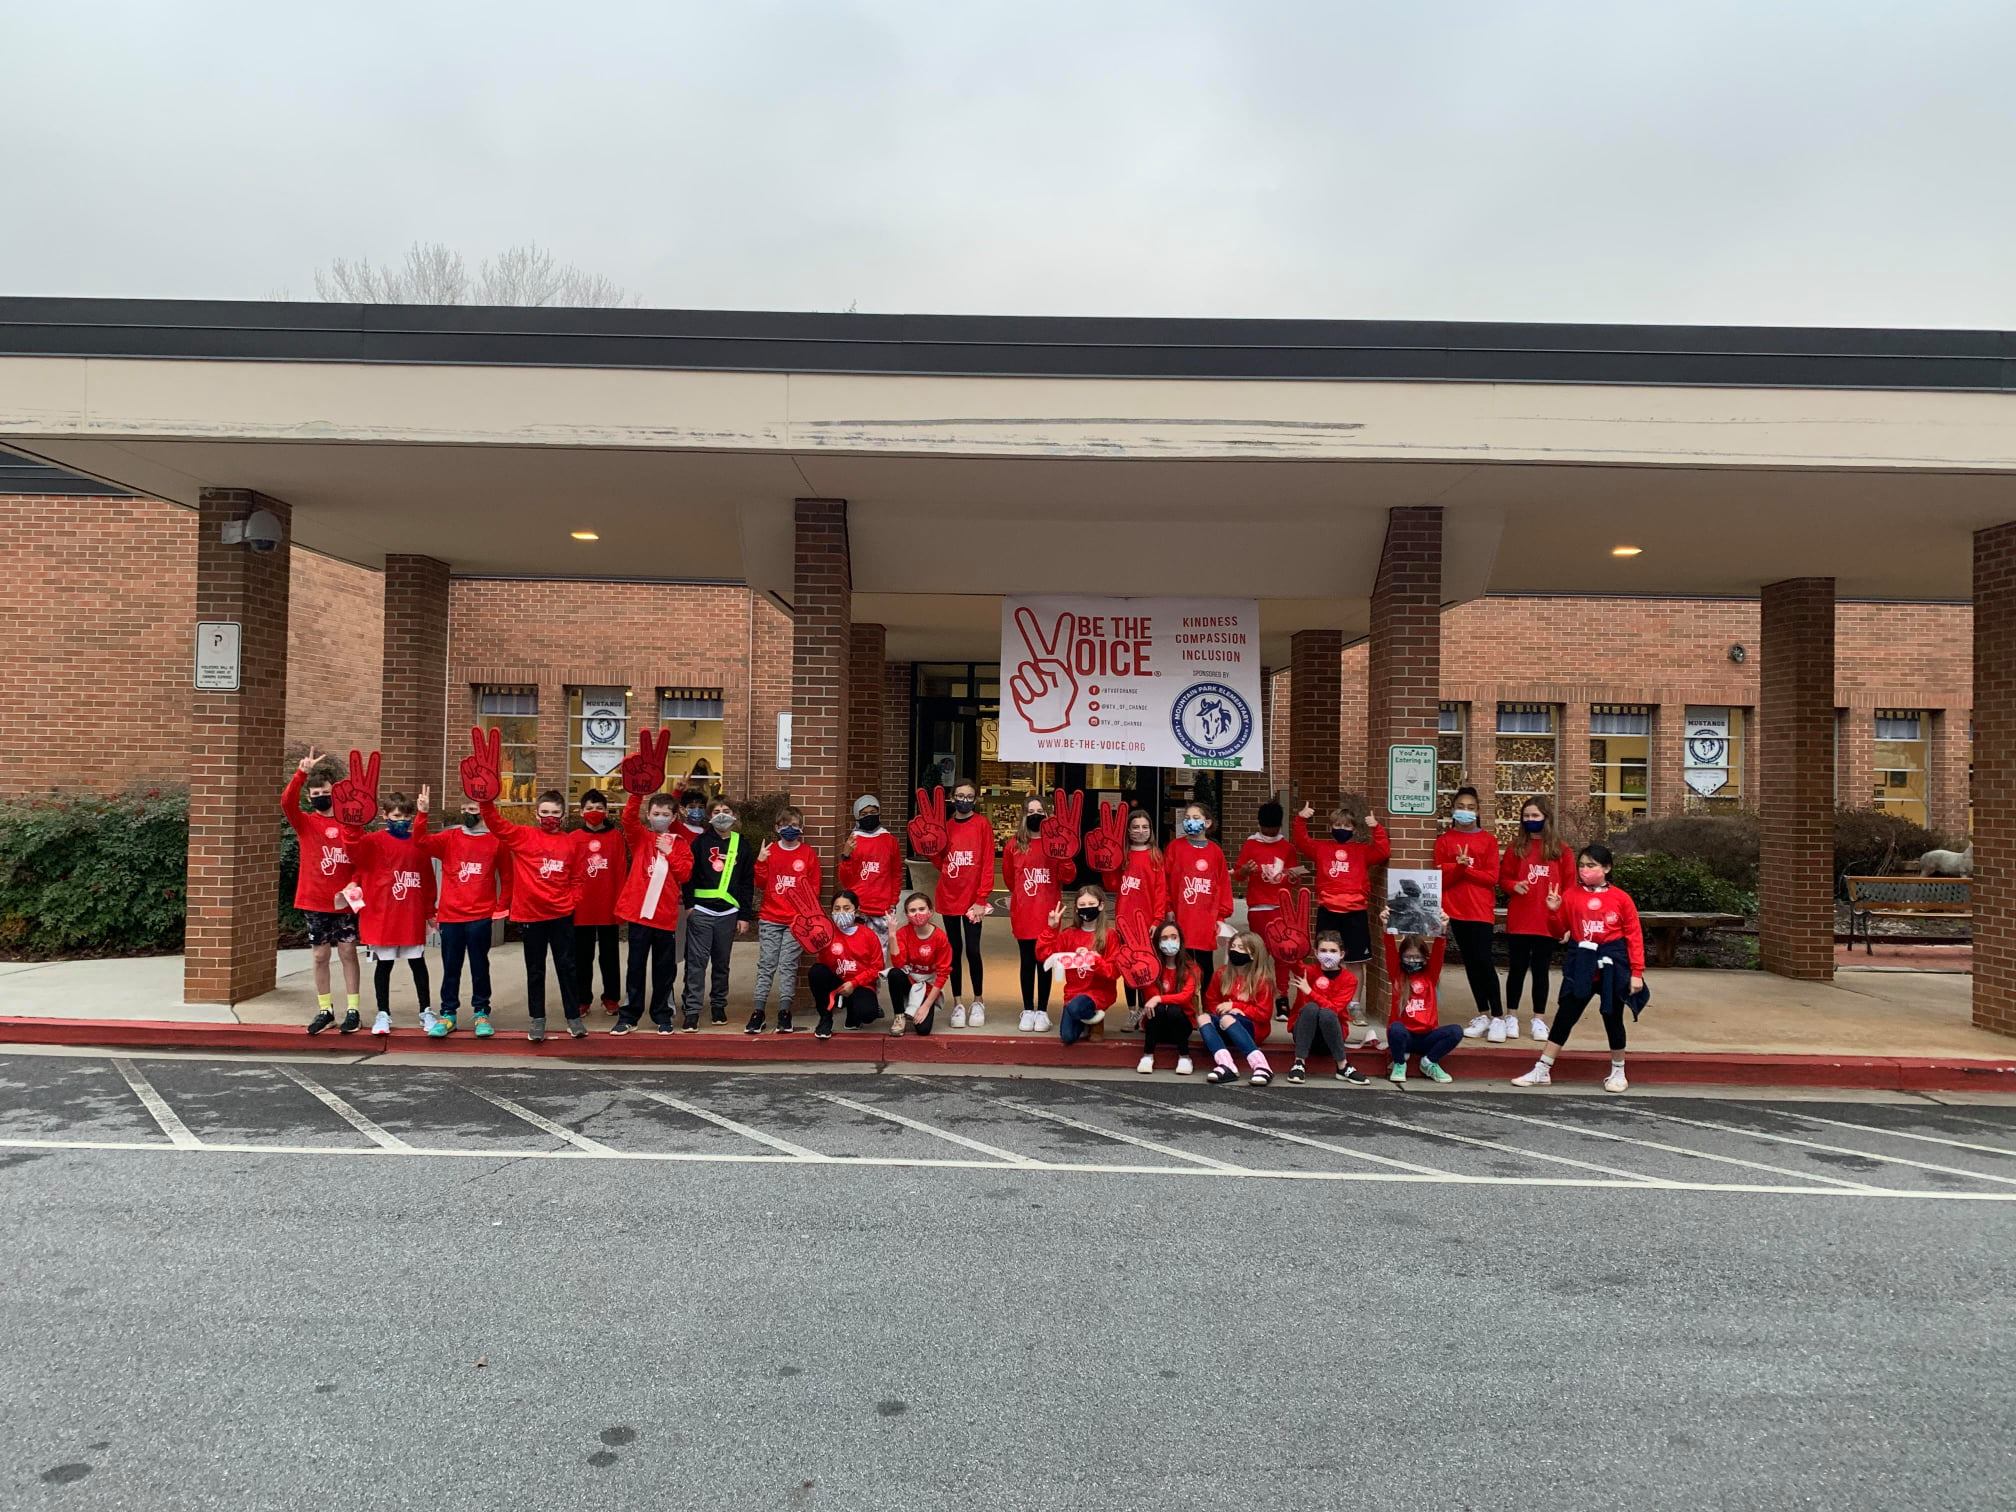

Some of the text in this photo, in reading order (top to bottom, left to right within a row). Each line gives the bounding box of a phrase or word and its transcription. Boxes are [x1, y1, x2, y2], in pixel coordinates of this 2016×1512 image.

[1078, 616, 1152, 639] BE THE
[1182, 616, 1238, 628] KINDNESS
[1175, 632, 1246, 644] COMPASSION
[1182, 649, 1241, 662] INCLUSION
[1174, 685, 1250, 724] MOUNTAIN PARK ELEMENTARY
[1037, 739, 1146, 752] WWW.BE-THE-VOICE.ORG
[1191, 745, 1207, 756] Think
[1217, 747, 1235, 757] Think
[1191, 757, 1236, 767] MUSTANGS
[1050, 849, 1068, 857] VOICE
